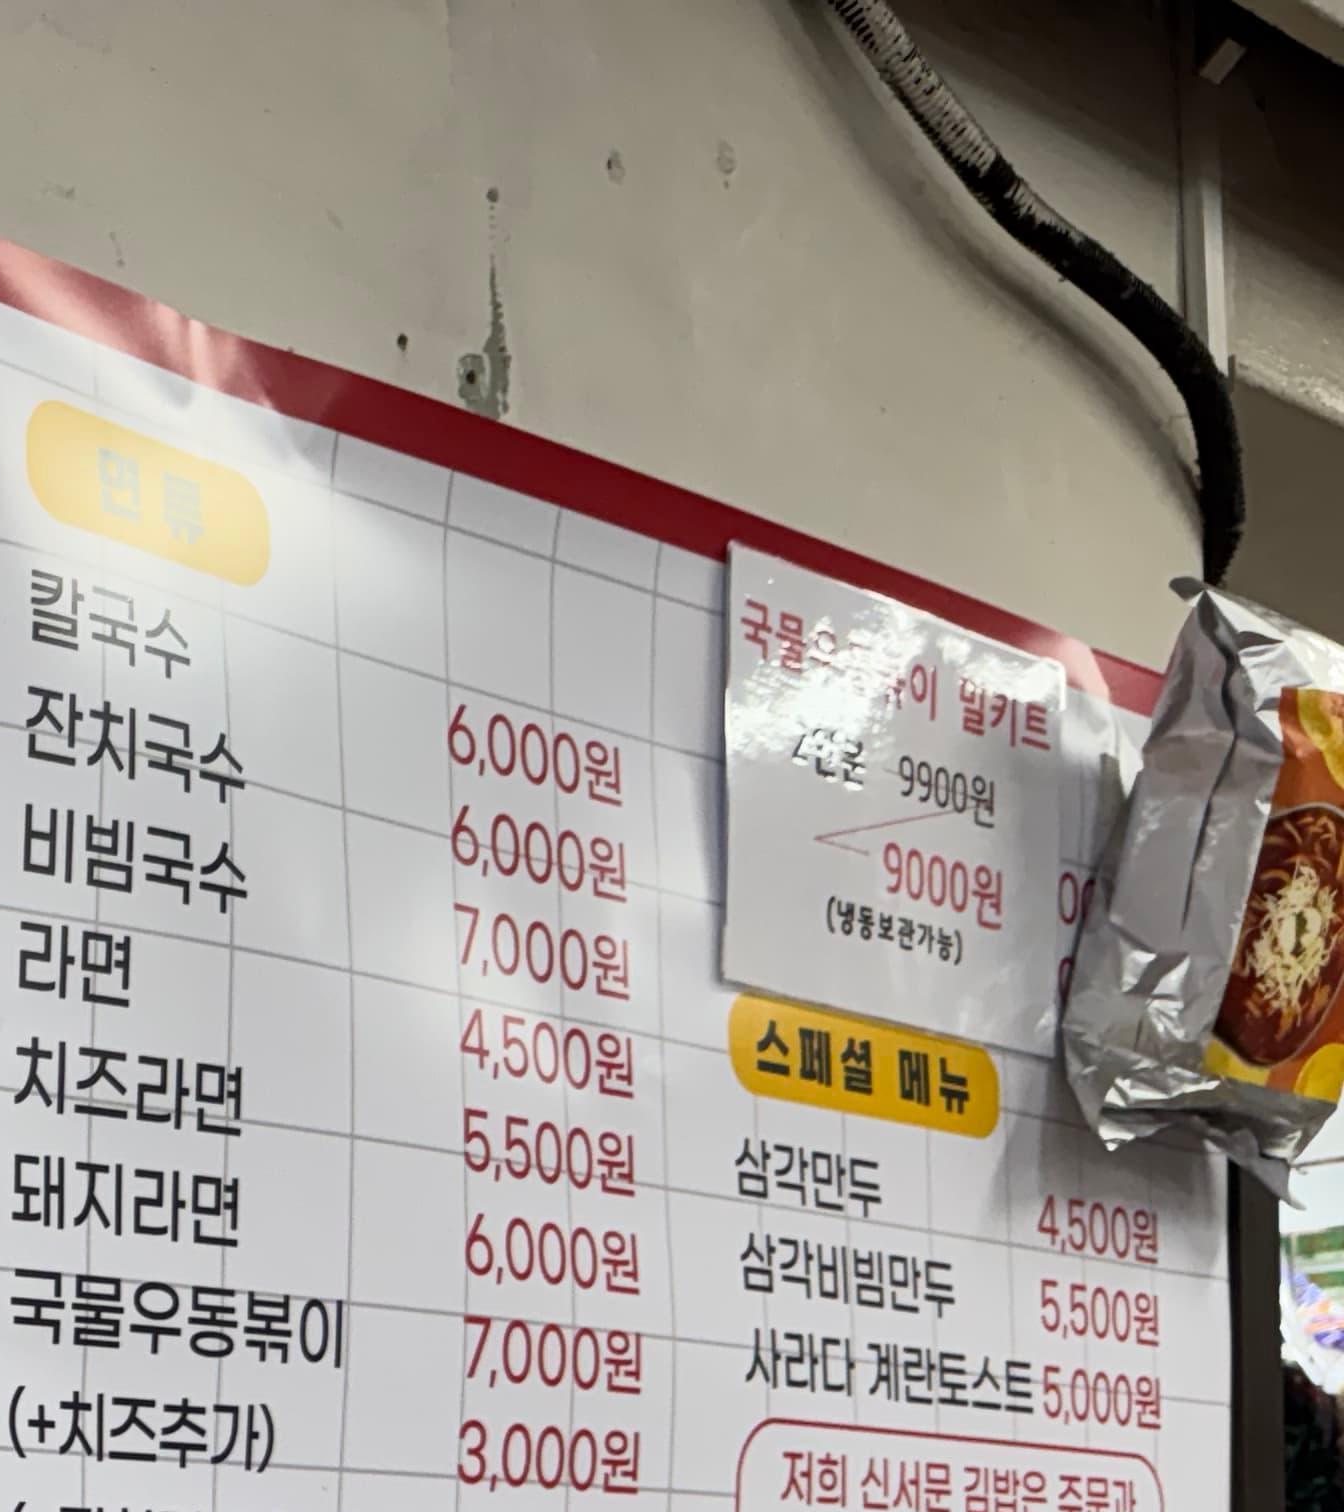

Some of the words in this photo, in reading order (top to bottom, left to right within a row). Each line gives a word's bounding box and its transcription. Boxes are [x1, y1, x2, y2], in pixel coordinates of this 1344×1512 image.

[30, 568, 191, 680] 칼국수
[447, 702, 624, 808] 6,000원
[25, 684, 246, 804] 잔치국수
[450, 804, 629, 904] 6,000원
[899, 756, 994, 828] 9900원
[22, 803, 249, 914] 비빔국수
[454, 903, 631, 1001] 7,000원
[826, 895, 963, 965] (냉동보관가능)
[882, 843, 1002, 930] 9000원
[17, 920, 132, 1007] 라면
[460, 1008, 635, 1099] 4,500원
[756, 1018, 874, 1096] 스페셜
[896, 1049, 971, 1114] 메뉴
[14, 1036, 243, 1137] 치즈라면
[463, 1107, 637, 1197] 5,500원
[11, 1152, 240, 1248] 돼지라면
[464, 1213, 641, 1296] 6,000원
[734, 1137, 882, 1219] 삼각만두
[1037, 1194, 1160, 1265] 4,500원
[10, 1267, 345, 1369] 국물우동볶이
[464, 1315, 643, 1395] 7,000원
[739, 1231, 956, 1319] 삼각비빔만두
[1040, 1279, 1161, 1347] 5,500원
[745, 1328, 855, 1397] 사라다
[868, 1341, 1034, 1414] 계란토스트
[1042, 1365, 1162, 1430] 5,000원
[8, 1386, 275, 1474] (+치즈추가)
[457, 1418, 641, 1495] 3,000원
[780, 1450, 847, 1508] 저희
